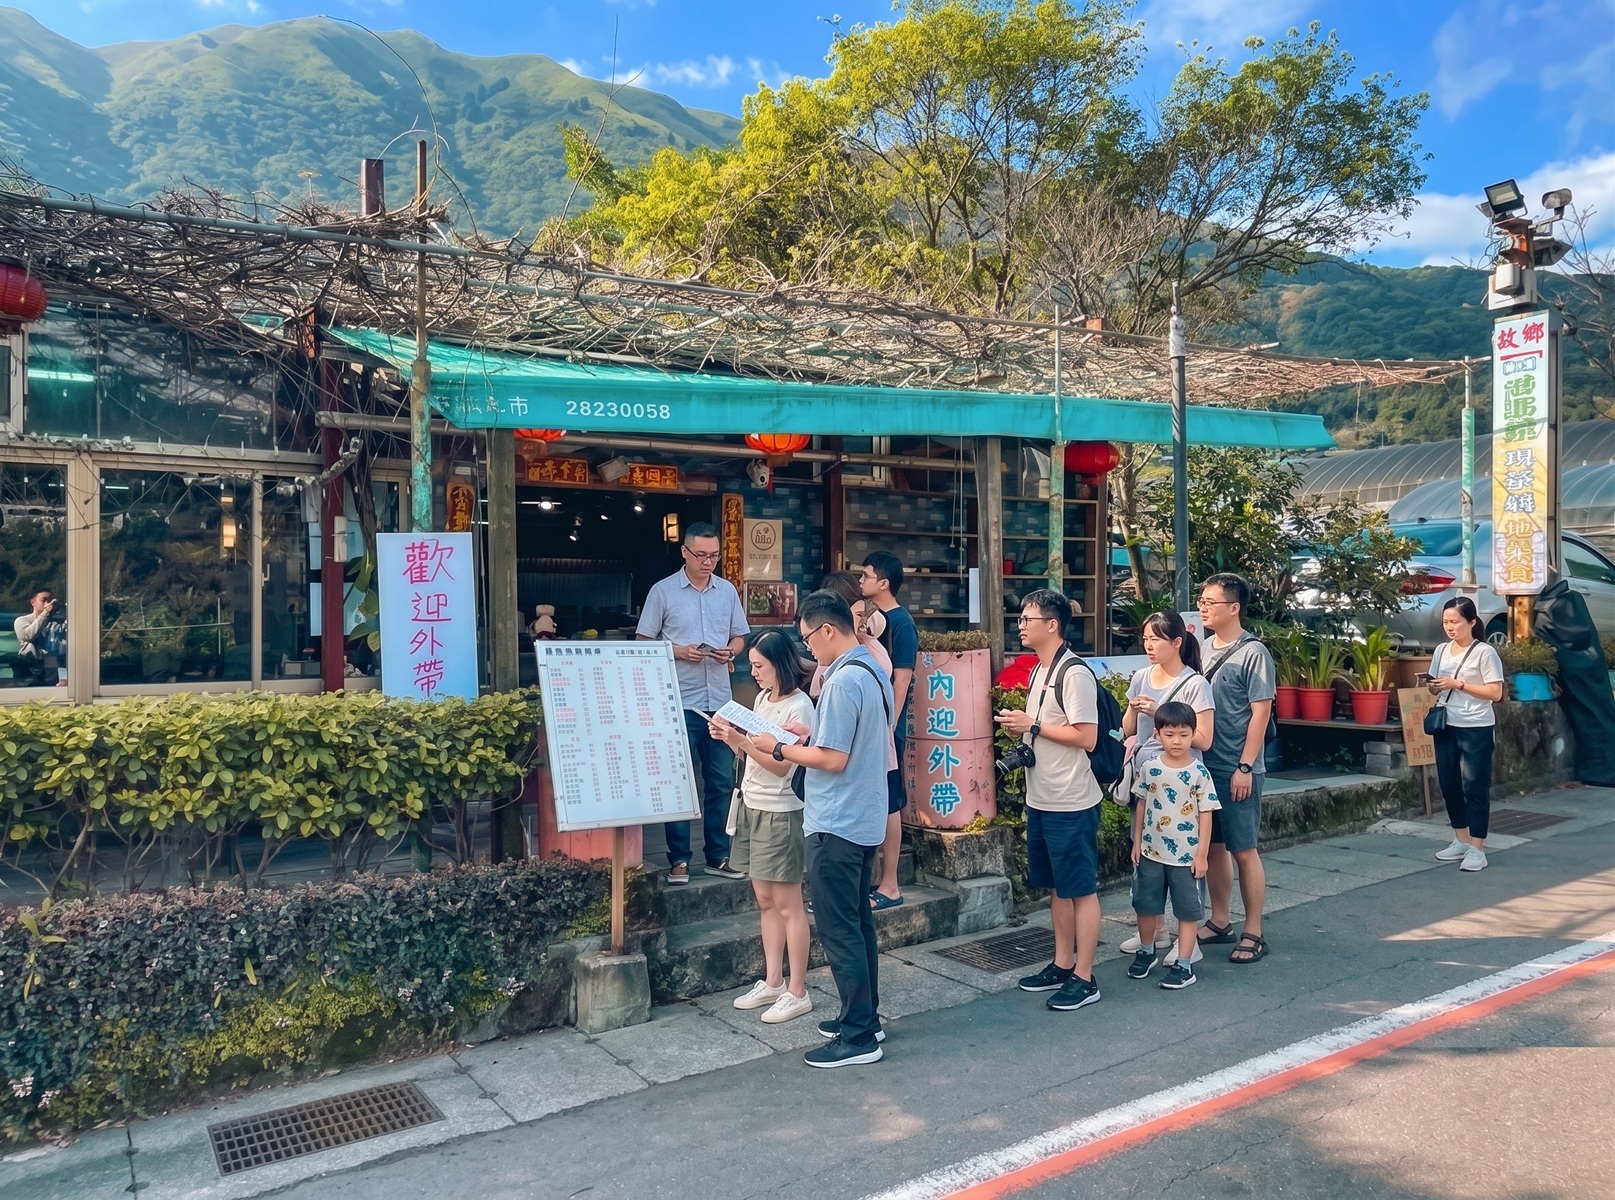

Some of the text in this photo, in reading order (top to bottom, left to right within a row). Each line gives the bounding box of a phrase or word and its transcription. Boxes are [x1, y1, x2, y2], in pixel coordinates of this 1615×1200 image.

[1497, 321, 1544, 350] 故鄉
[566, 400, 671, 420] 28230058
[402, 538, 455, 698] 歡迎外帶
